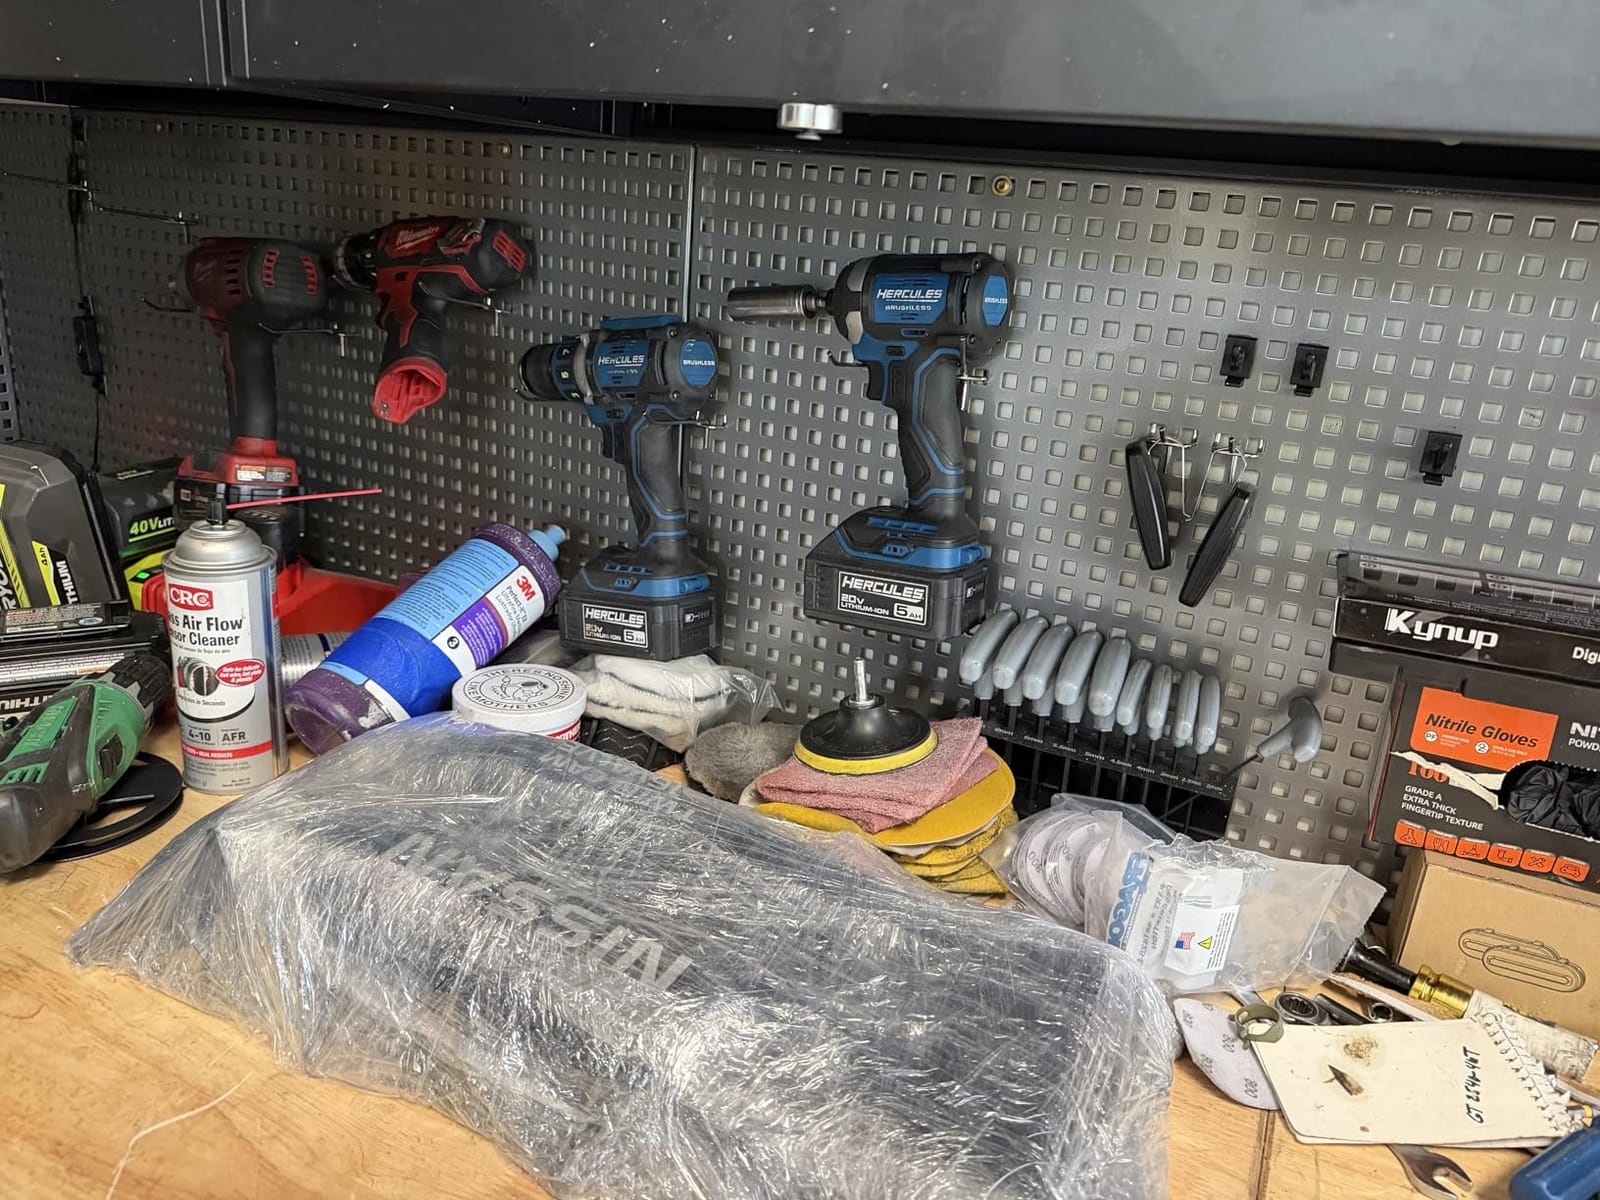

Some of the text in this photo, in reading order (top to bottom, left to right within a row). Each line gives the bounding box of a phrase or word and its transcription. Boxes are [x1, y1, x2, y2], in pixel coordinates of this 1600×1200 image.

[876, 288, 943, 300] HERCULES
[984, 296, 1008, 304] BRUSHLESS
[597, 355, 645, 366] HERCULES
[157, 518, 175, 529] LIT
[0, 558, 17, 610] RYO
[516, 575, 536, 601] 3M
[842, 576, 925, 600] HERCULES
[170, 587, 210, 608] CRC
[841, 593, 865, 605] 20V
[585, 607, 645, 625] HERCULES
[841, 602, 889, 616] LITHIUM-ION
[183, 614, 202, 630] Air
[206, 616, 243, 631] Flow
[585, 623, 603, 633] 20V
[1384, 607, 1499, 650] Kynup
[189, 631, 240, 646] Cleaner
[0, 694, 53, 711] ITHIU
[188, 728, 211, 741] 4-10
[222, 731, 246, 742] AFR
[1425, 713, 1477, 735] Nitrile
[1481, 725, 1539, 748] Gloves
[1568, 737, 1600, 753] POWD
[1405, 785, 1442, 801] GRADE A
[1403, 793, 1457, 815] EXTRA THICK
[1401, 802, 1484, 831] FINGERTIP TEXTURE
[392, 833, 693, 991] NISSAN
[1244, 1078, 1258, 1099] 800
